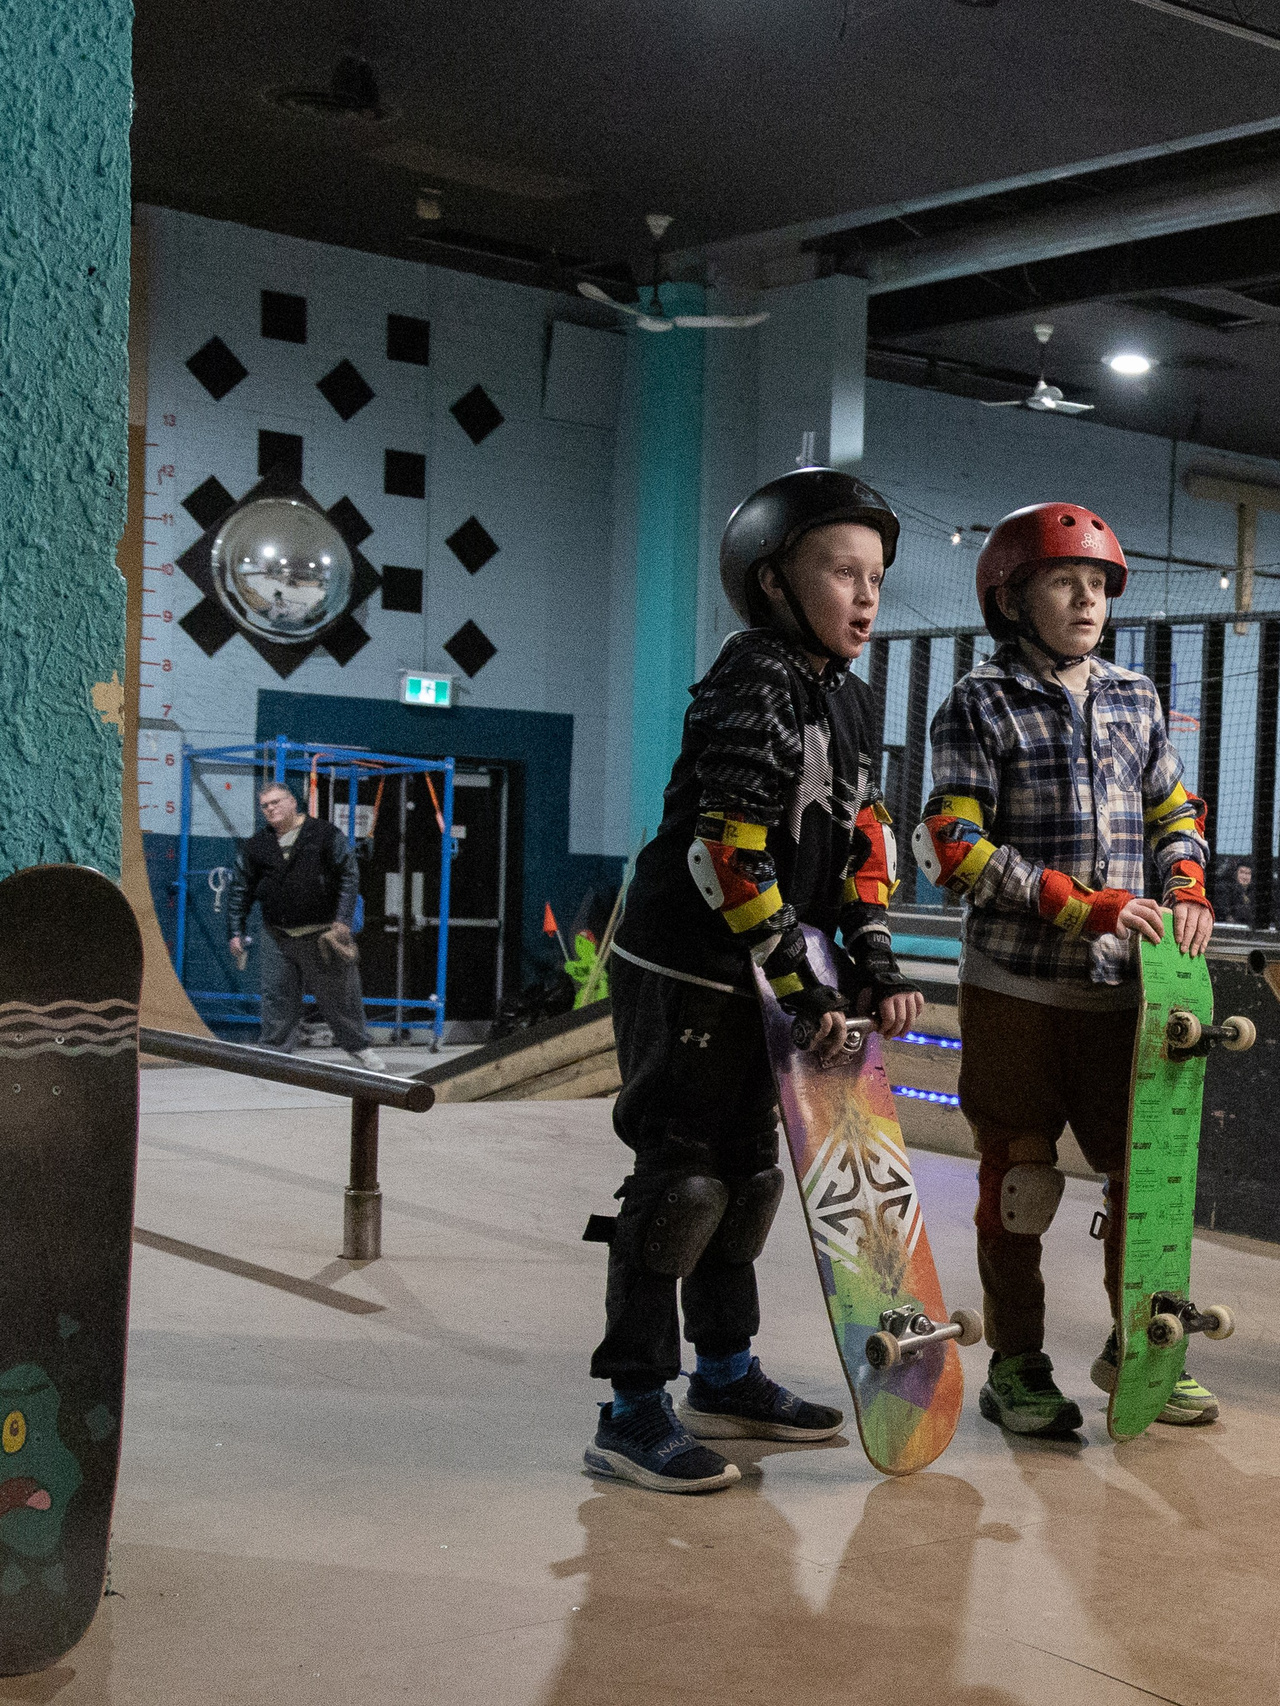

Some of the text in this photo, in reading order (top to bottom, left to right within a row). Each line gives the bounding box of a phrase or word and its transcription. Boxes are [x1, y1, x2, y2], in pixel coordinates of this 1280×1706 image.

[162, 704, 172, 717] 7
[165, 754, 175, 766] 6
[165, 801, 175, 814] 5
[657, 1434, 694, 1457] NAUT
